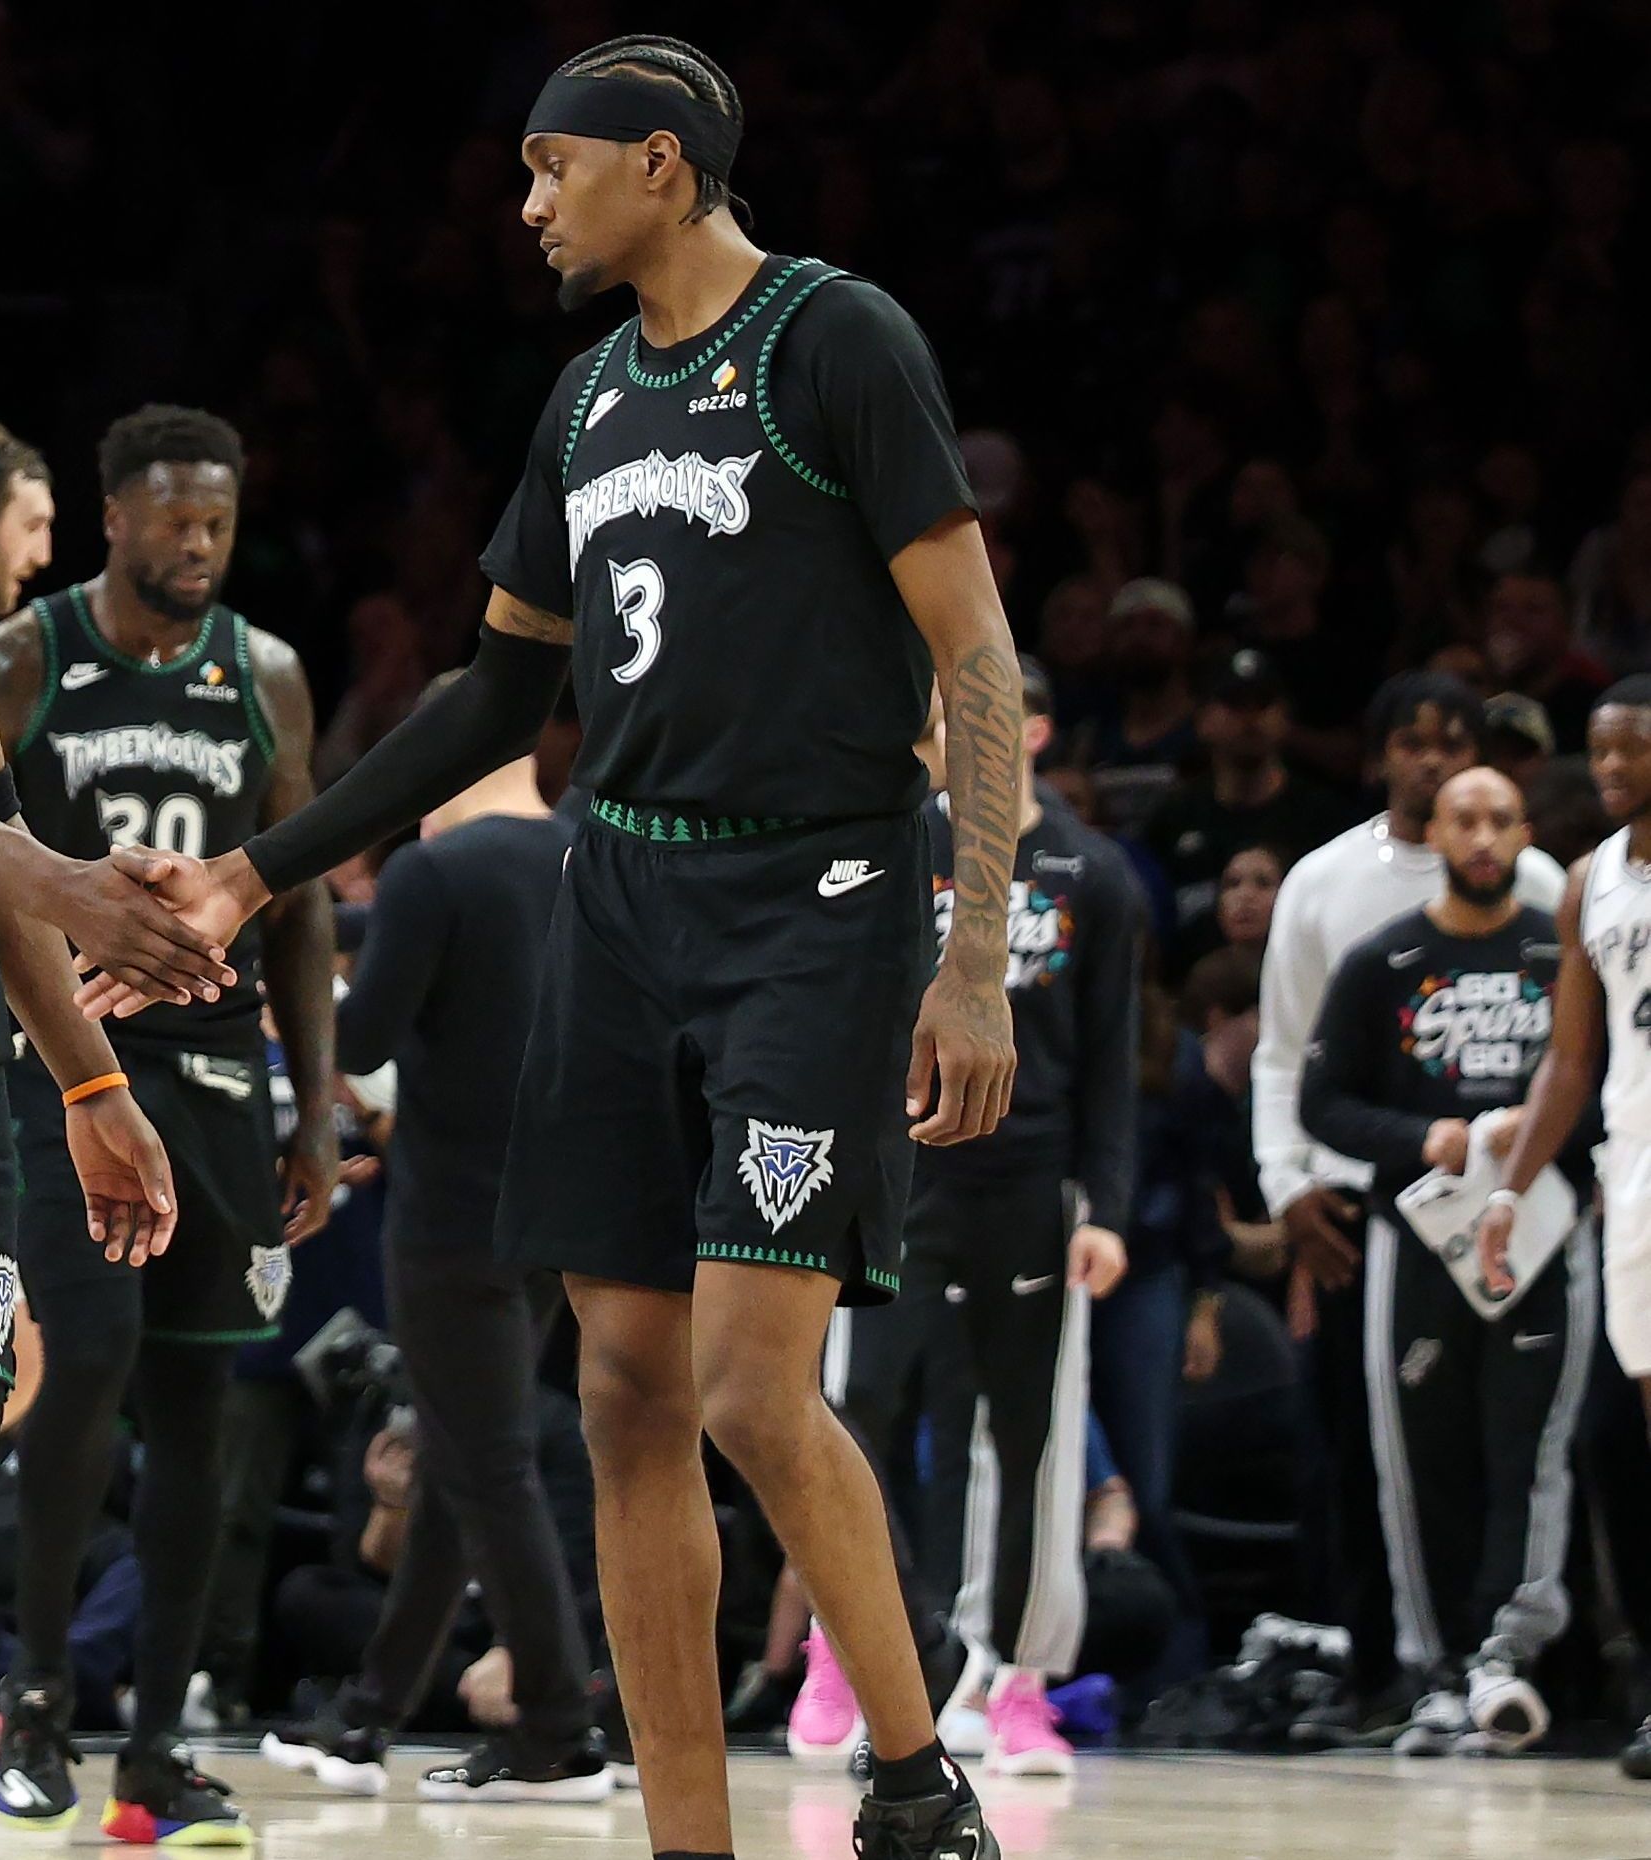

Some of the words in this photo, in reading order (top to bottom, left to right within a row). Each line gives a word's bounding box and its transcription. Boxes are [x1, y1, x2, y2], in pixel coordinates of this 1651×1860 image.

[688, 389, 747, 415] sezzle
[565, 449, 763, 583] TIMBERWOLVES
[607, 558, 665, 684] 3
[46, 721, 250, 801] TIMBERWOLVES
[828, 860, 870, 882] NIKE
